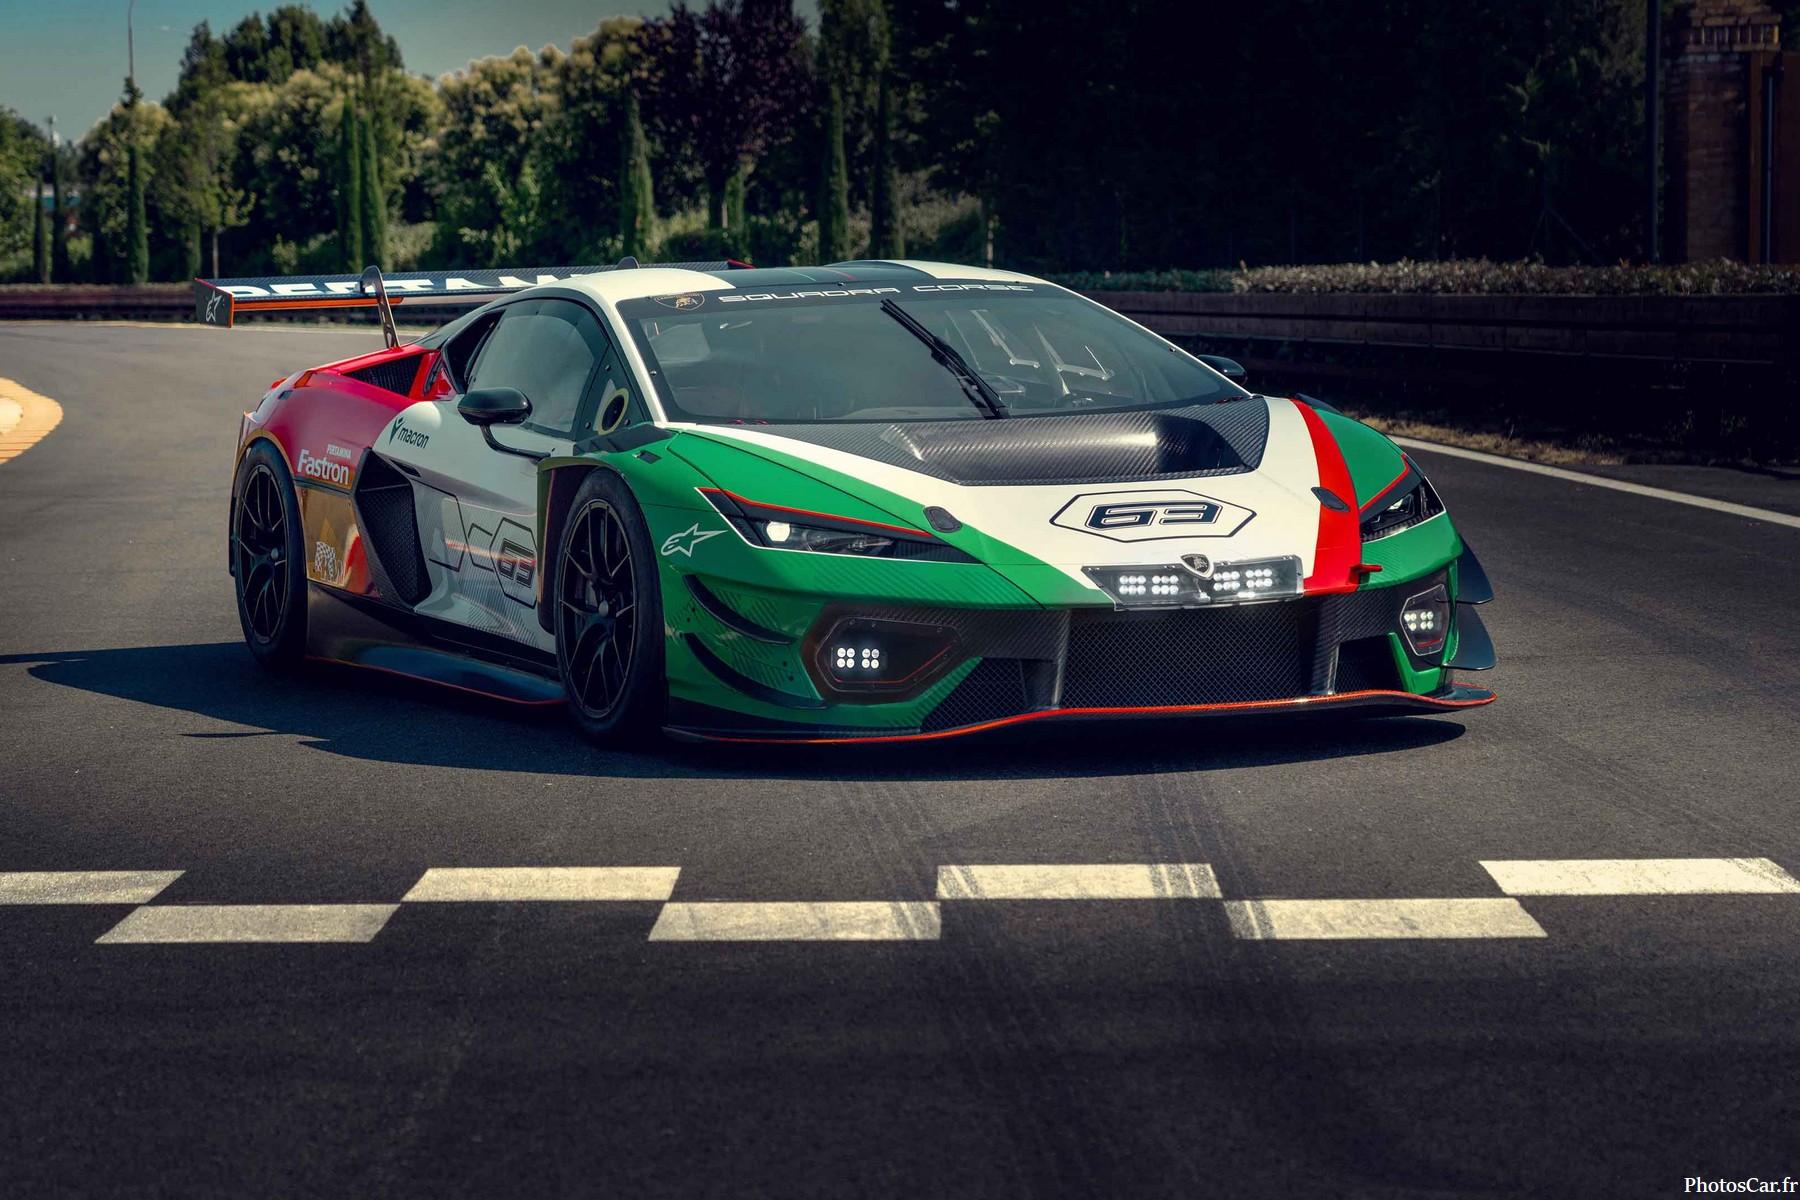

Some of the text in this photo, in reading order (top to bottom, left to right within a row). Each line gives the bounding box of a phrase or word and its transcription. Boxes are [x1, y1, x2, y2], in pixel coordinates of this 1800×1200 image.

[718, 284, 1034, 302] SQUADRA CORSE
[397, 427, 429, 449] macron
[297, 448, 350, 485] Fastron
[1085, 501, 1222, 531] 63
[497, 537, 536, 589] 63
